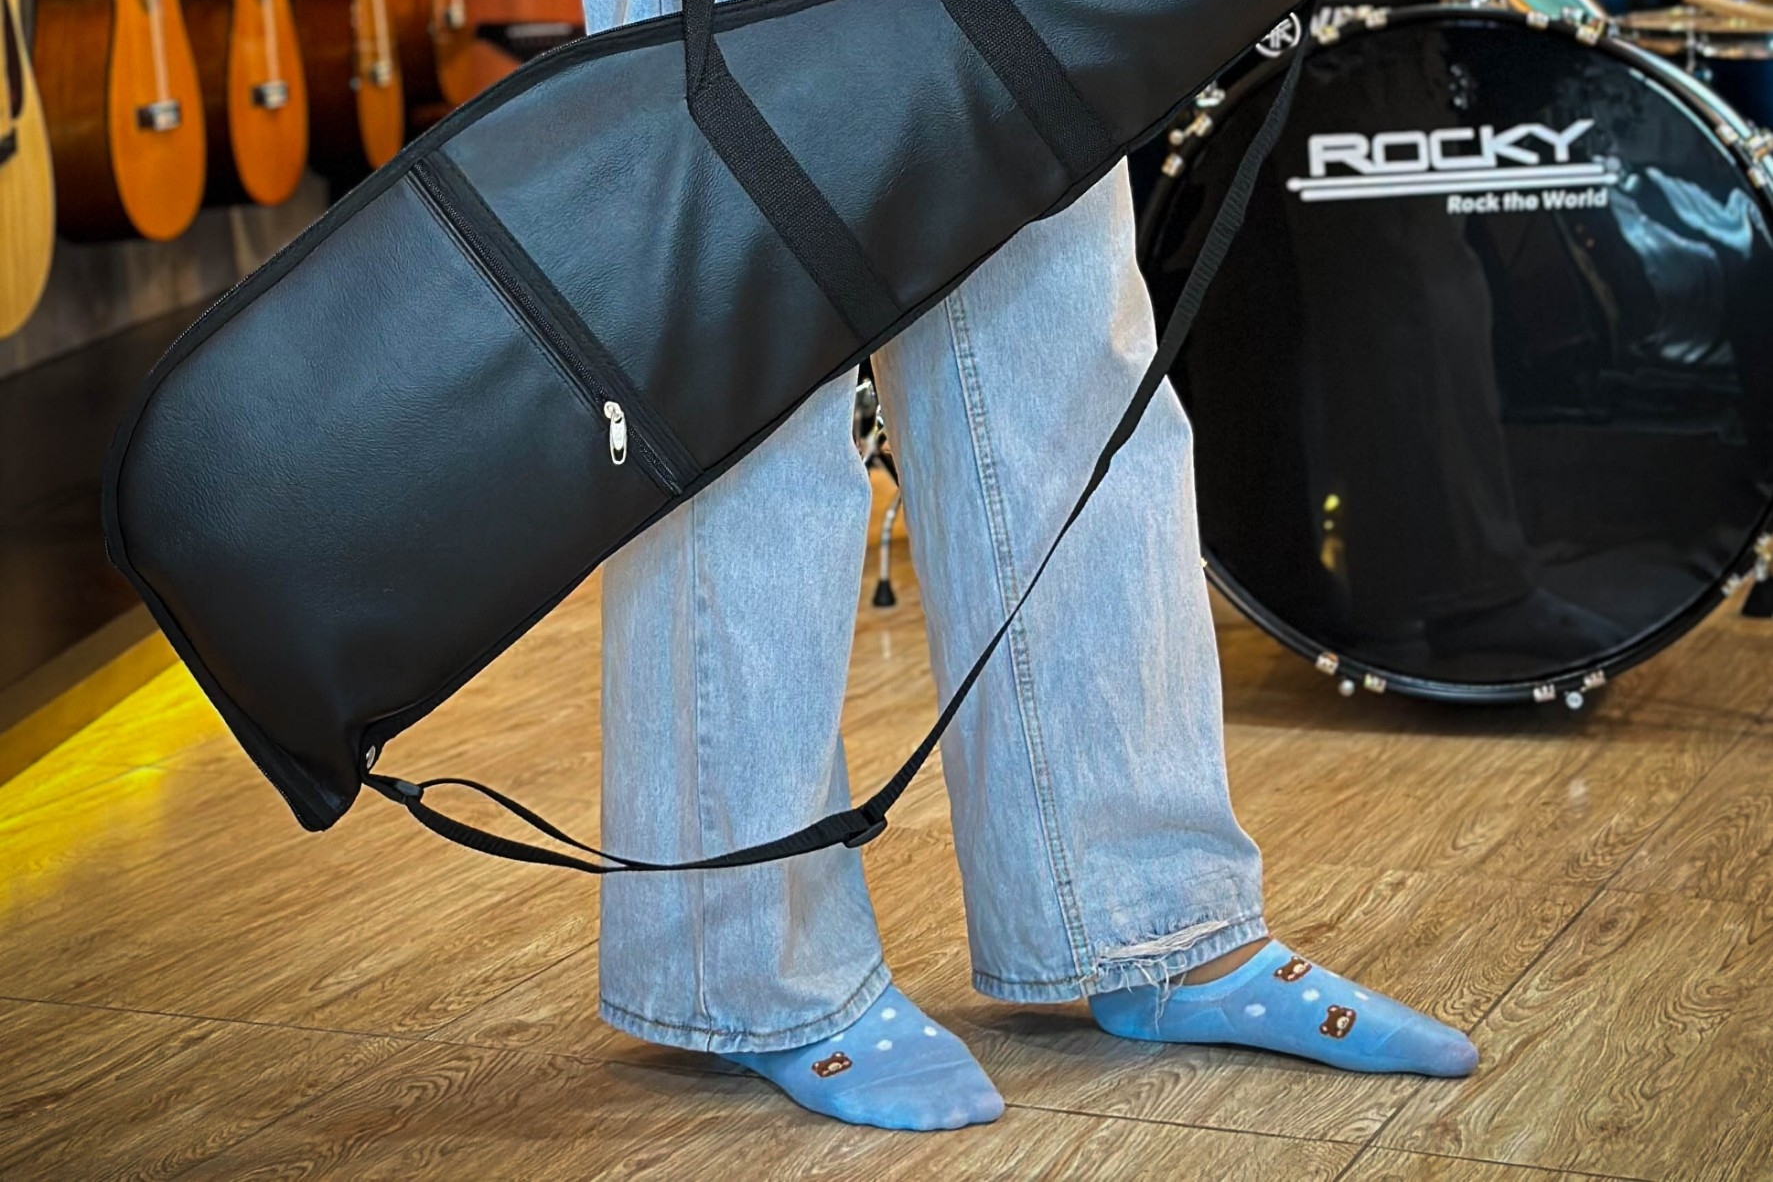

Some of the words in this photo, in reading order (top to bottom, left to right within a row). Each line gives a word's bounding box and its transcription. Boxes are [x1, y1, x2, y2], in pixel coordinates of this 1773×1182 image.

[1307, 119, 1596, 178] ROCKY
[1446, 192, 1500, 215] Rock
[1502, 190, 1539, 211] the
[1541, 187, 1608, 210] World
